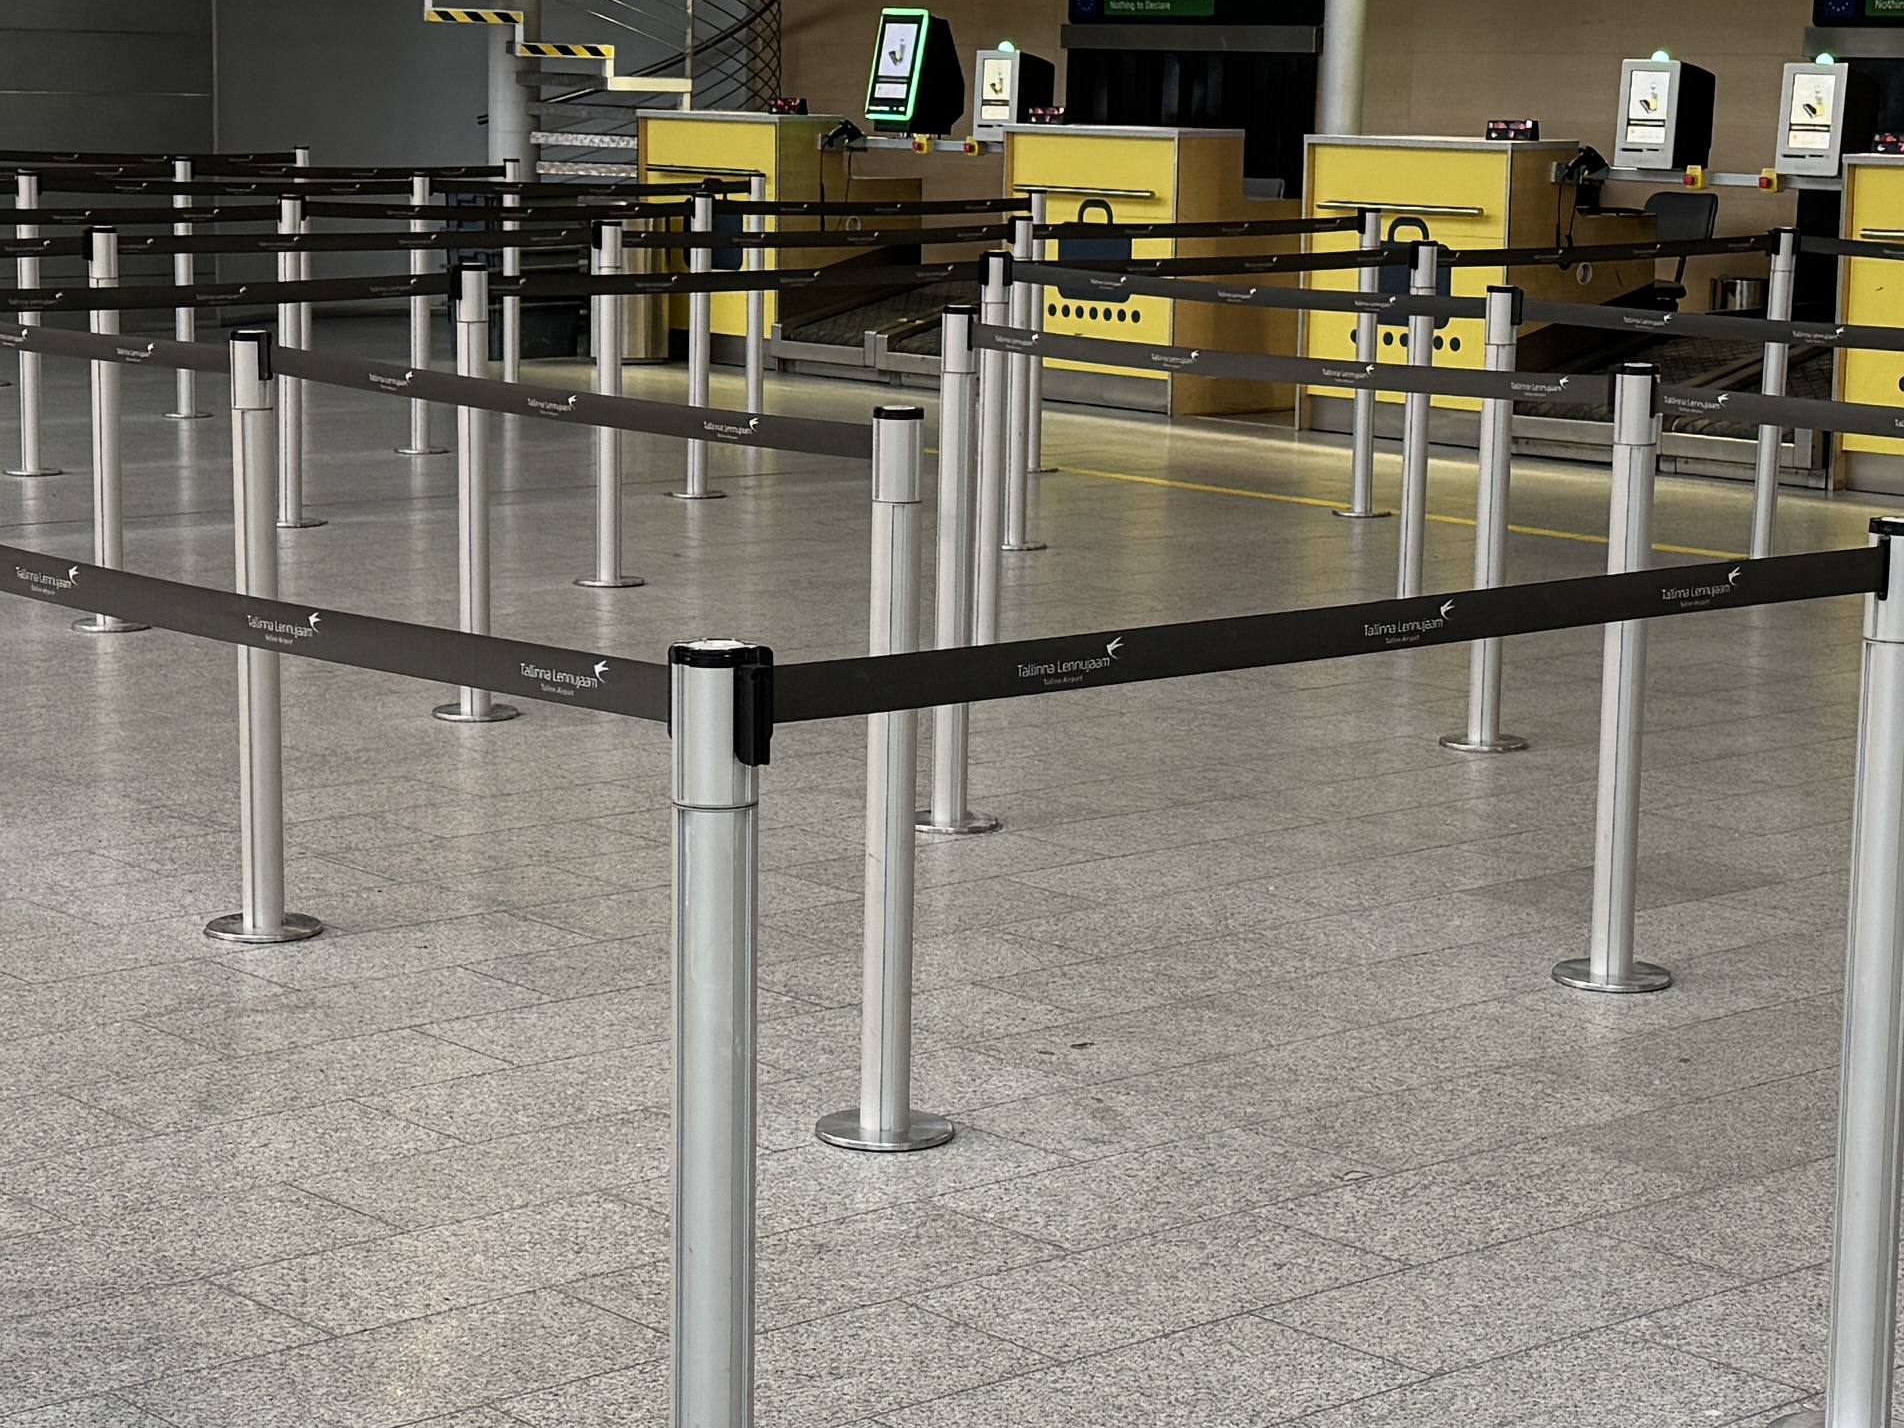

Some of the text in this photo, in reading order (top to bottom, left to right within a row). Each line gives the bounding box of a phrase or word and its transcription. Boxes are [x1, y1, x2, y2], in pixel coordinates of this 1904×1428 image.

[247, 614, 313, 639] Tallinna Lennujaam
[1364, 617, 1444, 636] Tallinna Lennujaam
[520, 662, 598, 690] Tallinna Lennujaam
[1017, 656, 1110, 678] Tallinna Lennujaam
